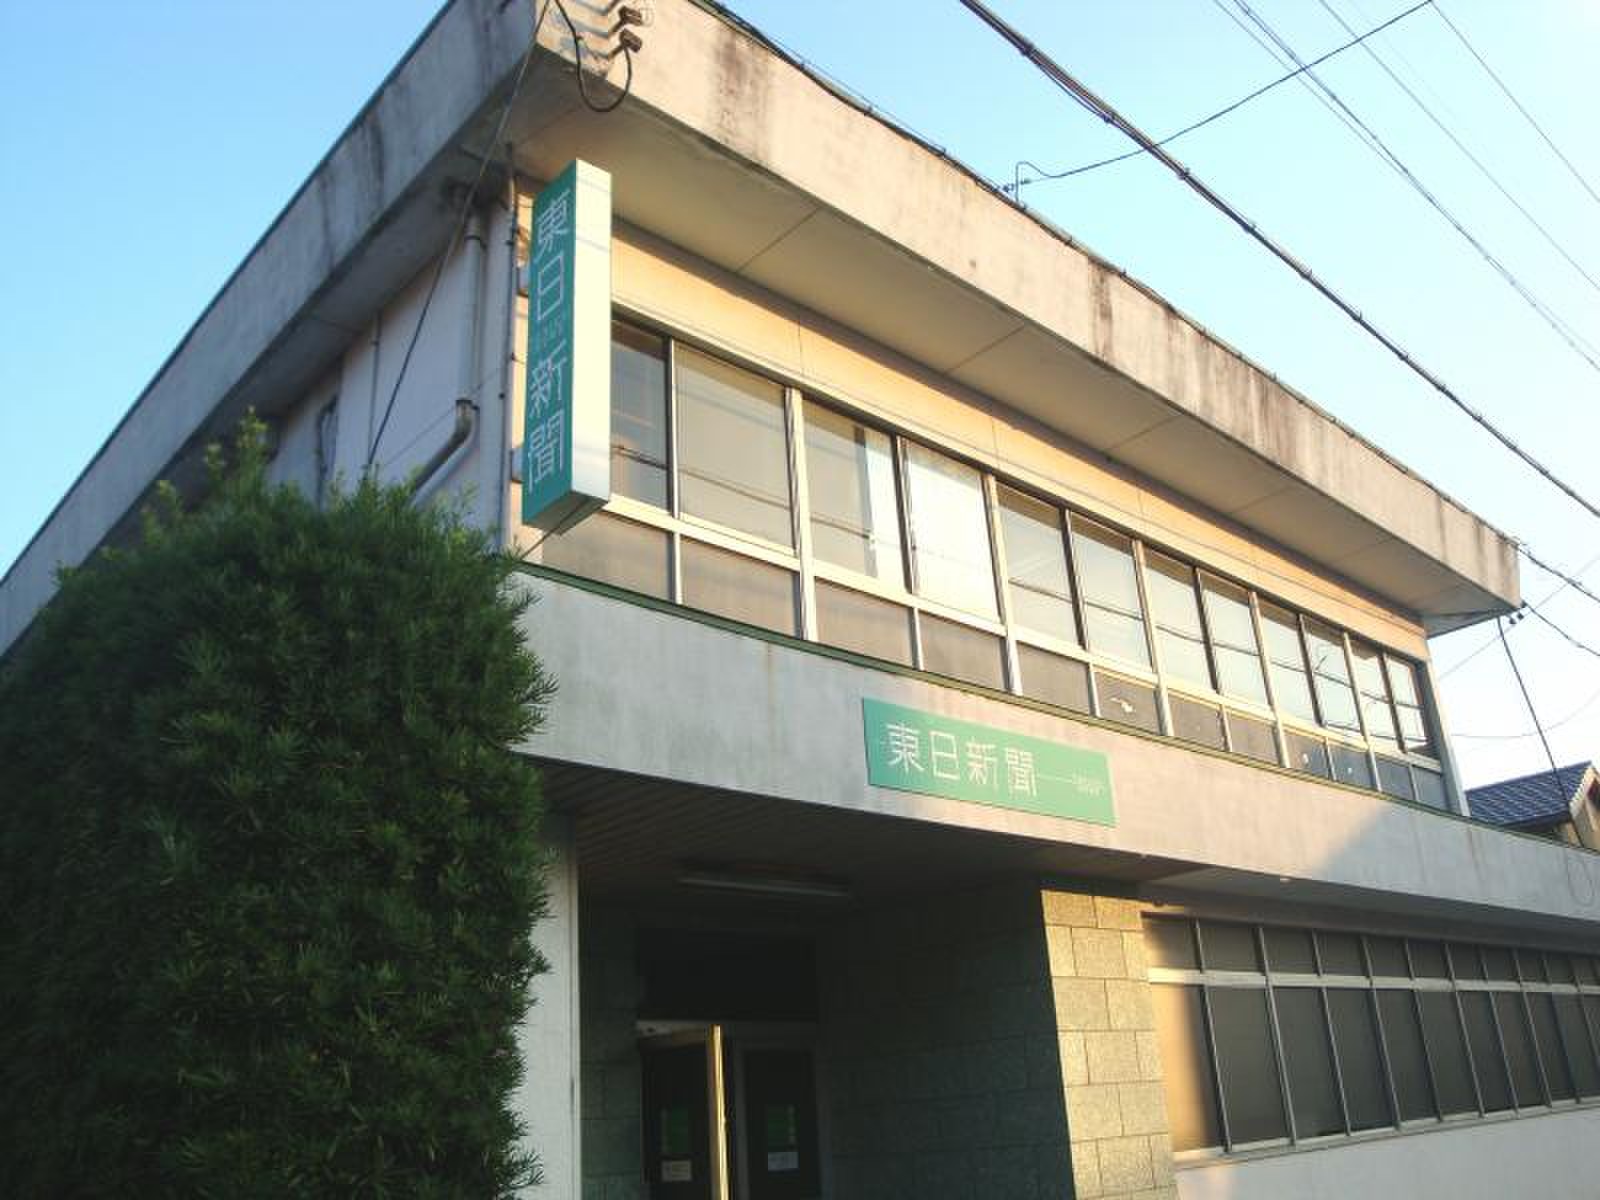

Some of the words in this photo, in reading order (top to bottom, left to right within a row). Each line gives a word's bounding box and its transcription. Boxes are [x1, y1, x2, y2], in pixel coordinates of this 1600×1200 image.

[527, 188, 571, 493] 東日新聞
[884, 721, 1038, 797] 東日新聞
